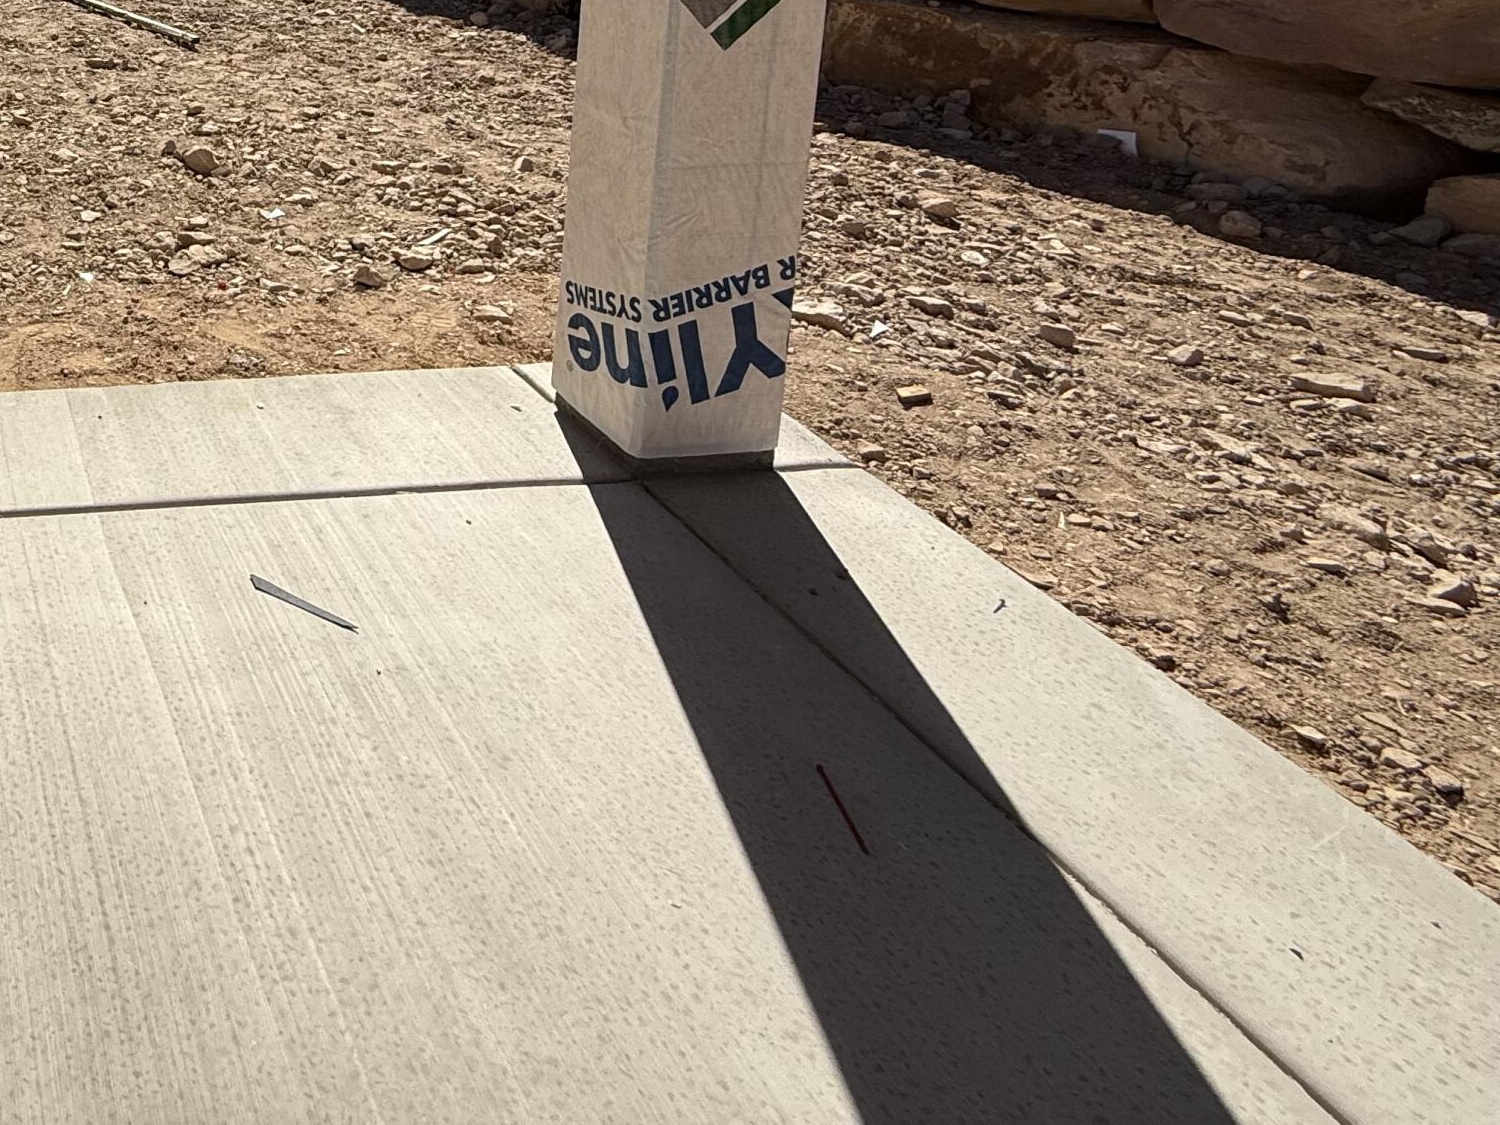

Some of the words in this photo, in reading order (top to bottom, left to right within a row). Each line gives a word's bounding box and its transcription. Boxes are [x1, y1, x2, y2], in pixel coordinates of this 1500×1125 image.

[565, 280, 642, 322] SYSTEMS
[647, 264, 771, 322] BARRIER
[567, 287, 795, 413] Yline
